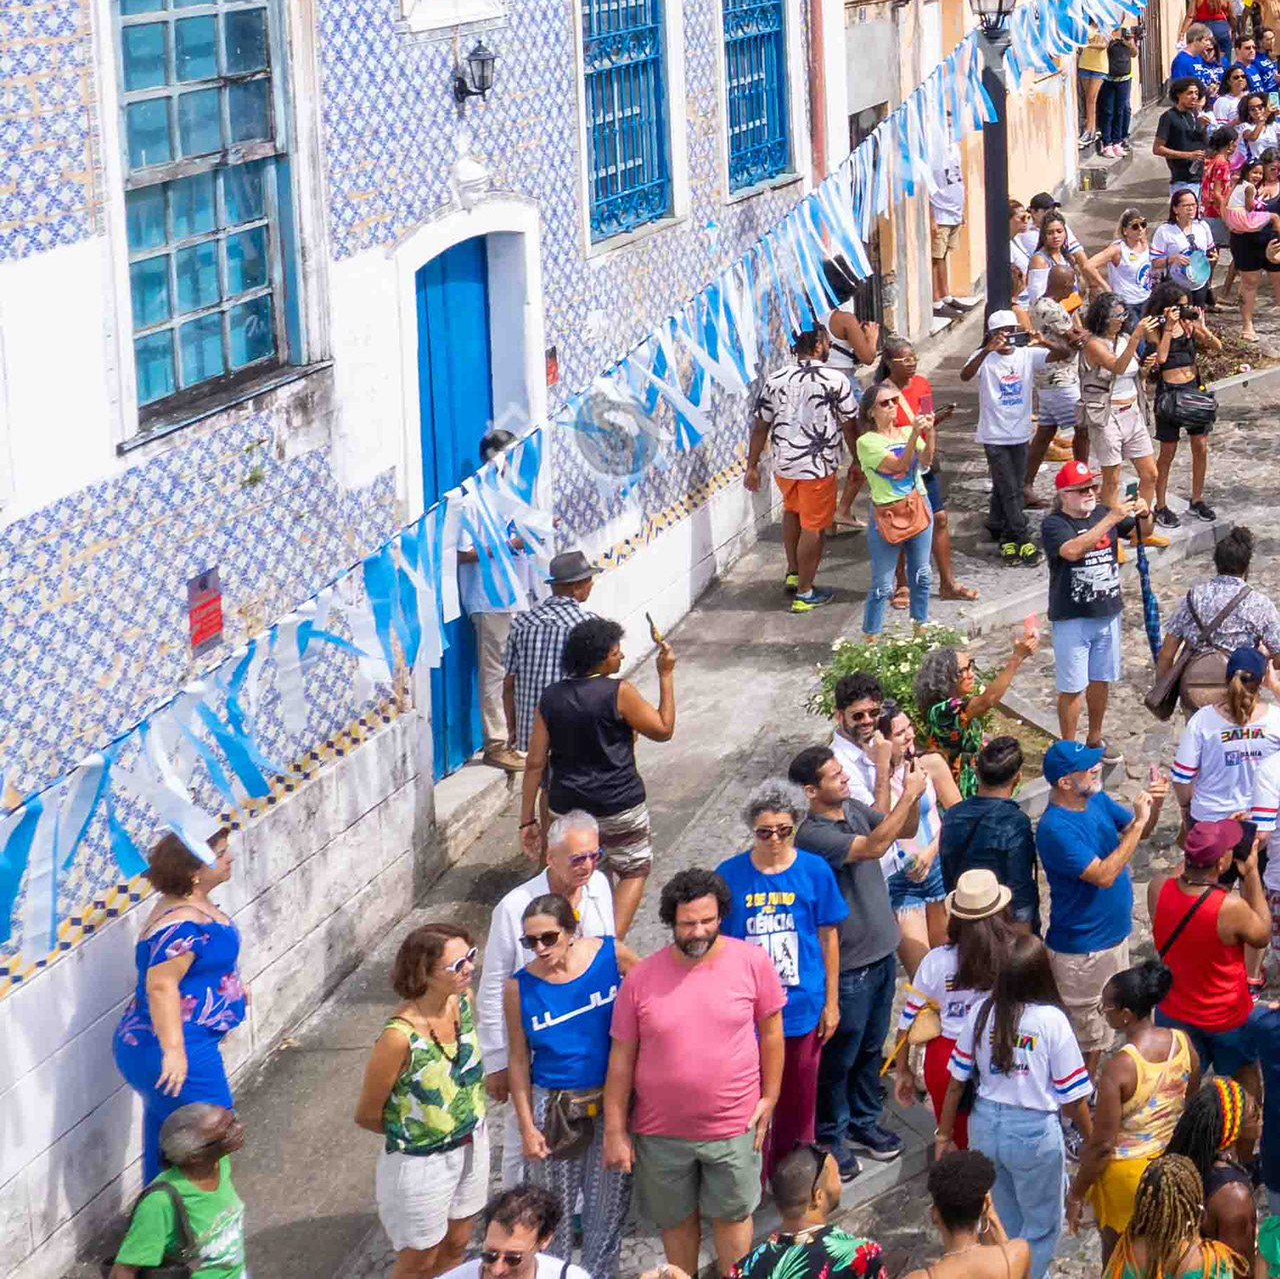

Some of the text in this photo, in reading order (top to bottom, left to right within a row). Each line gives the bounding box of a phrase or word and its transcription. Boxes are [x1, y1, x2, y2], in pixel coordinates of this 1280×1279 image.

[745, 893, 754, 908] 2
[754, 892, 766, 907] DE
[746, 912, 795, 934] CIÊNCIA
